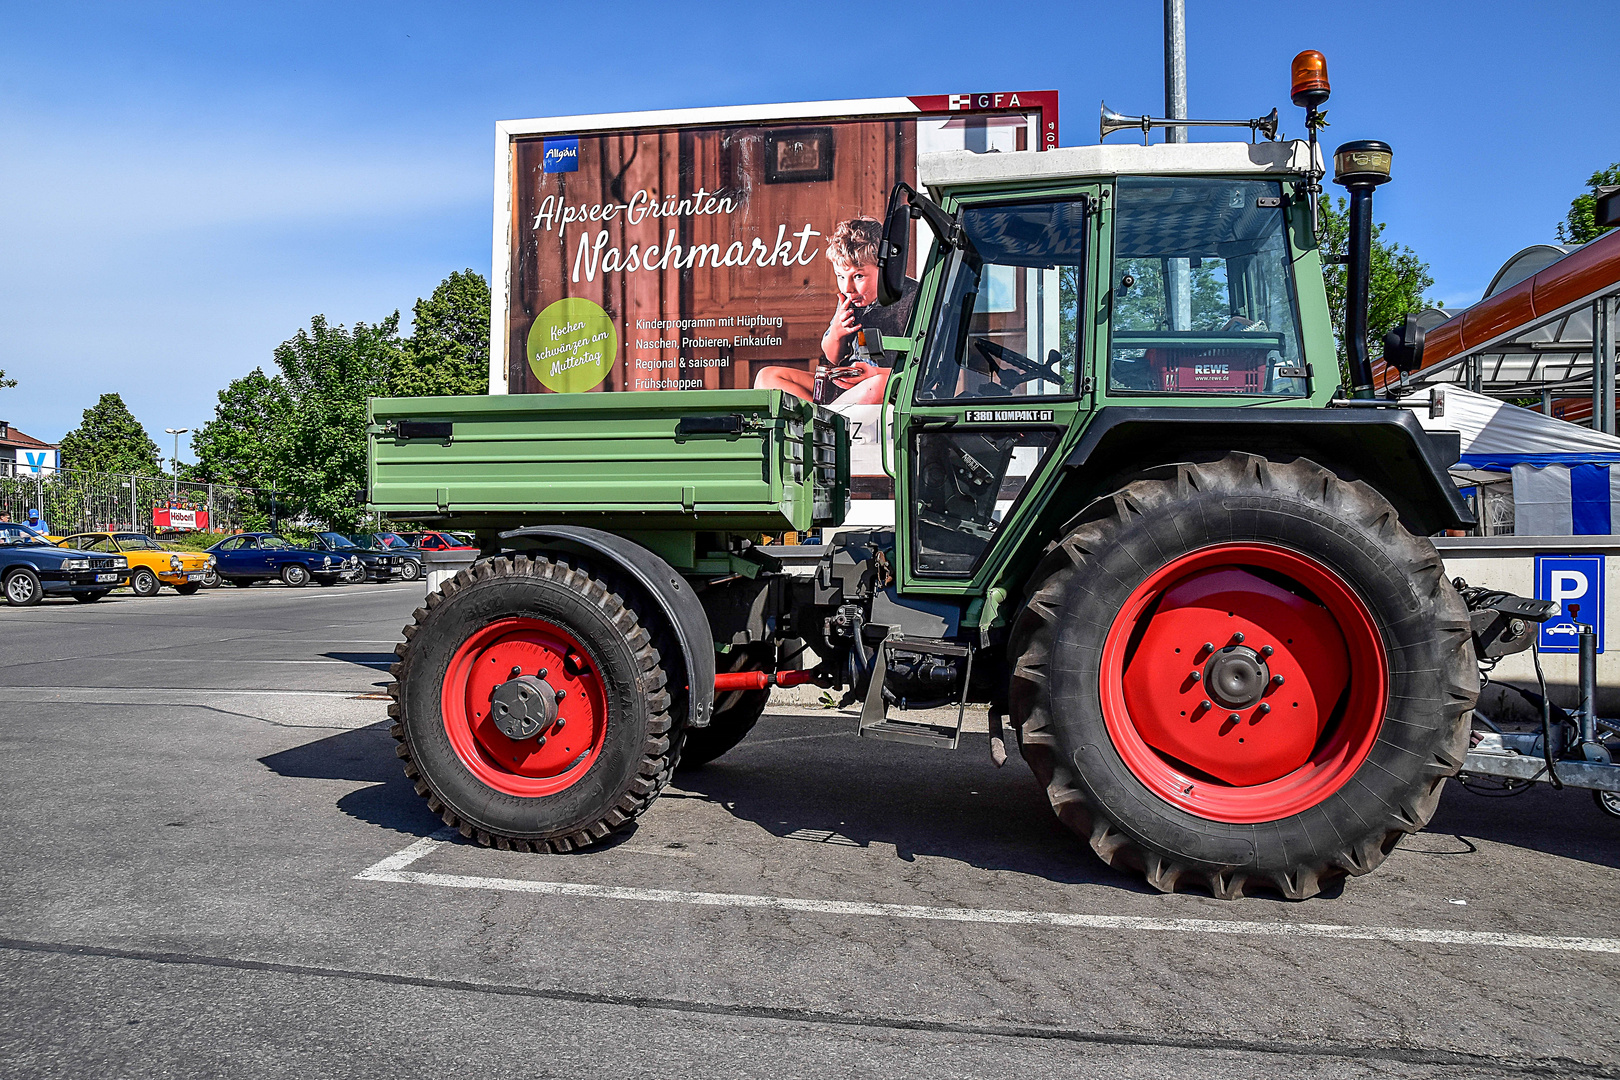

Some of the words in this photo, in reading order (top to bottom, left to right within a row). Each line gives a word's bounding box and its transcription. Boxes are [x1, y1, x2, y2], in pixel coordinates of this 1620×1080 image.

[978, 93, 1021, 108] GFA
[545, 146, 577, 163] Allgäu
[532, 187, 738, 237] Alpsee-Grünten
[571, 223, 821, 283] Naschmarkt
[550, 321, 586, 341] Kochen
[635, 318, 716, 331] Kinderprogramm
[718, 316, 734, 327] mit
[736, 314, 783, 328] Hüpfburg
[536, 337, 591, 361] schwänzen
[592, 331, 609, 343] am
[635, 337, 680, 350] Naschen,
[682, 336, 731, 348] Probieren,
[734, 334, 782, 347] Einkaufen
[549, 351, 603, 377] Muttertag
[635, 357, 676, 371] Regional
[679, 357, 686, 368] &
[688, 356, 730, 367] saisonal
[1195, 364, 1229, 375] REWE
[635, 377, 703, 391] Frühschoppen
[966, 411, 972, 421] F
[973, 411, 993, 421] 380
[1551, 570, 1589, 616] P
